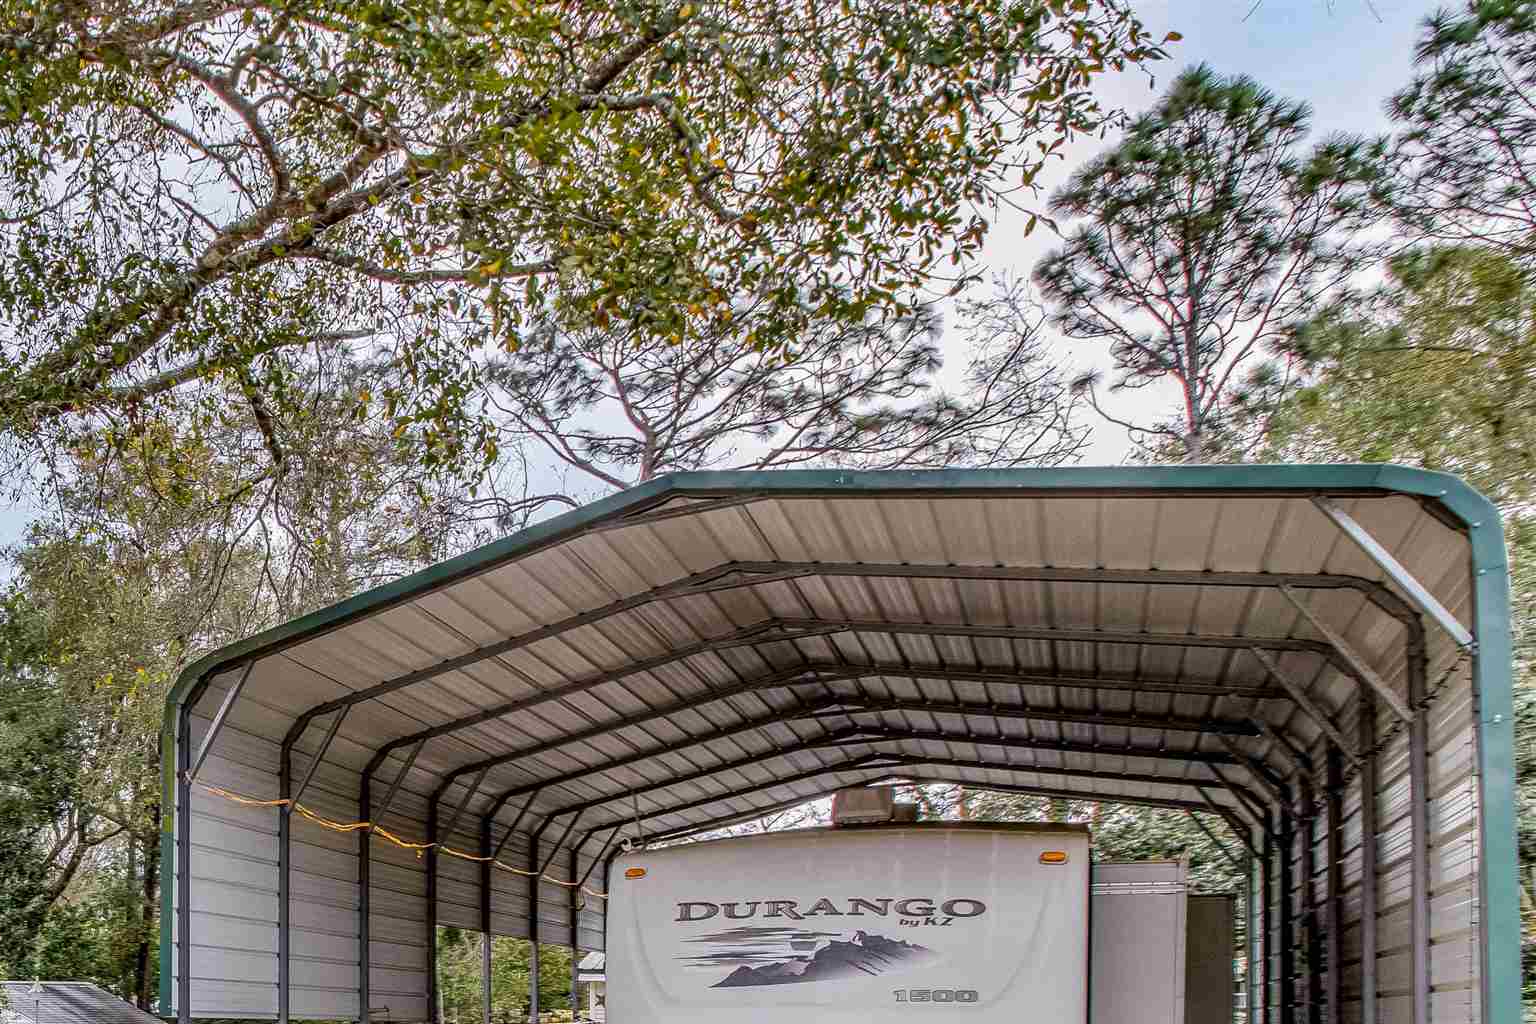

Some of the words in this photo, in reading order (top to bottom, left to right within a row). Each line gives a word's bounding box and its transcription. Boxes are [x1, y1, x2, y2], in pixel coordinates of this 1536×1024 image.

[674, 898, 986, 921] DURANGO
[899, 918, 920, 928] by
[924, 917, 953, 927] KZ
[894, 990, 978, 1002] 1500
